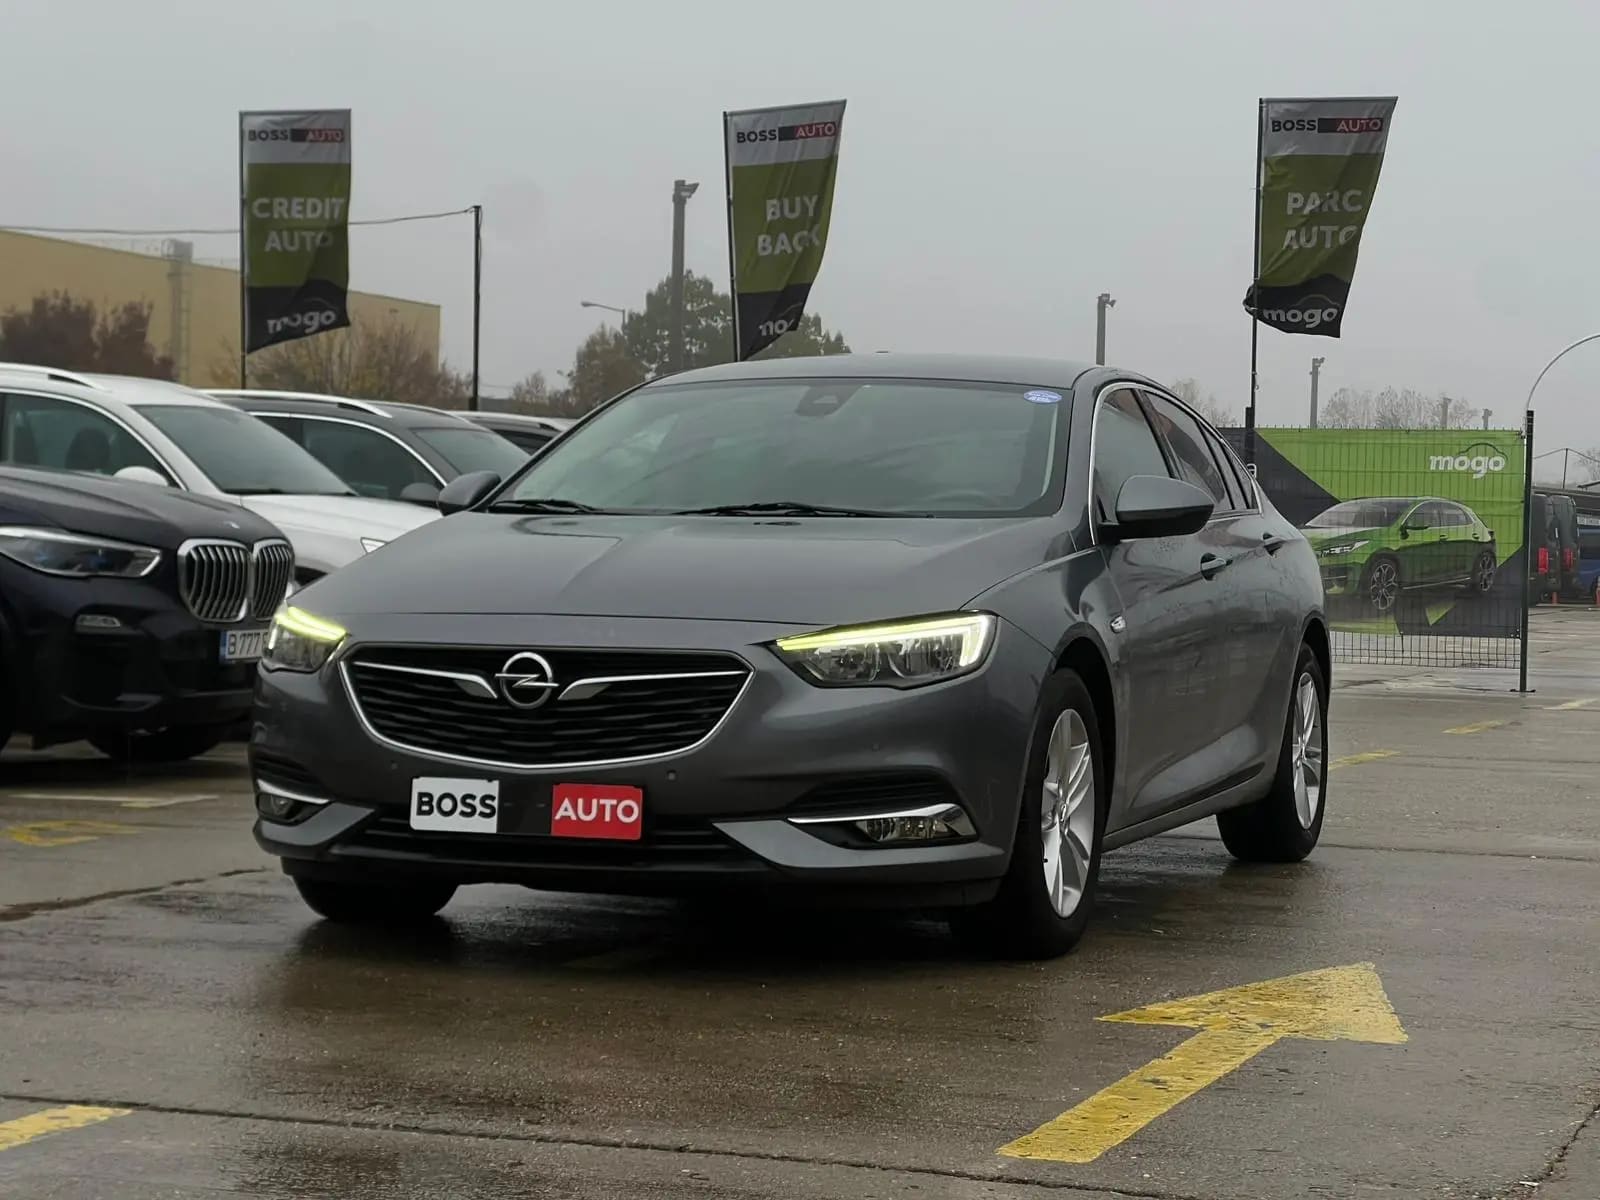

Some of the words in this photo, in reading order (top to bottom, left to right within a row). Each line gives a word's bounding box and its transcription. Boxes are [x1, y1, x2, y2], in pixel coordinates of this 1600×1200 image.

[248, 129, 289, 142] BOSS
[305, 129, 343, 142] AUTO
[736, 128, 777, 143] BOSS
[795, 123, 836, 138] AUTO
[1271, 119, 1317, 132] BOSS
[1336, 119, 1382, 132] AUTO
[252, 198, 345, 219] CREDIT
[765, 195, 818, 222] BUY
[1286, 189, 1364, 215] PARC
[264, 230, 333, 252] AUTO
[1281, 225, 1358, 250] AUTO
[1263, 307, 1338, 328] mogo
[1429, 455, 1506, 479] mogo
[416, 792, 497, 819] BOSS
[554, 797, 640, 824] AUTO
